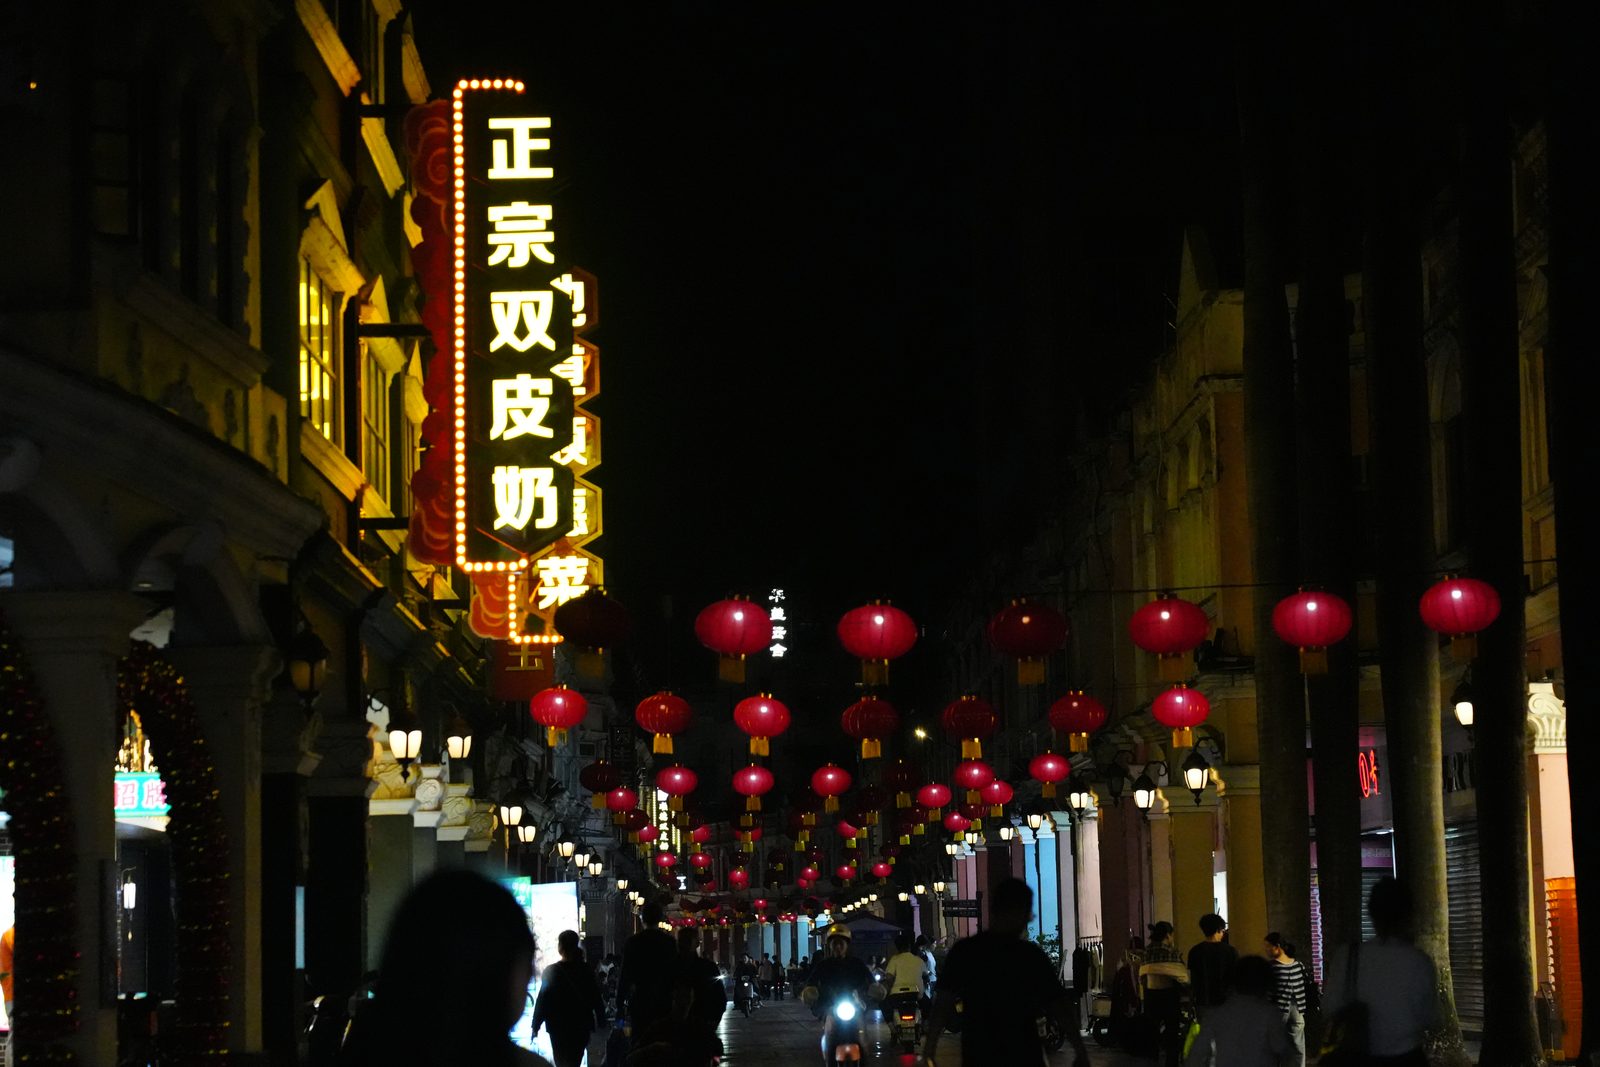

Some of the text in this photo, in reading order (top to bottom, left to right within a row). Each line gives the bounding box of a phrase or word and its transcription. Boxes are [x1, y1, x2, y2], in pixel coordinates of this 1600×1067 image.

[487, 116, 559, 531] 正宗双皮奶
